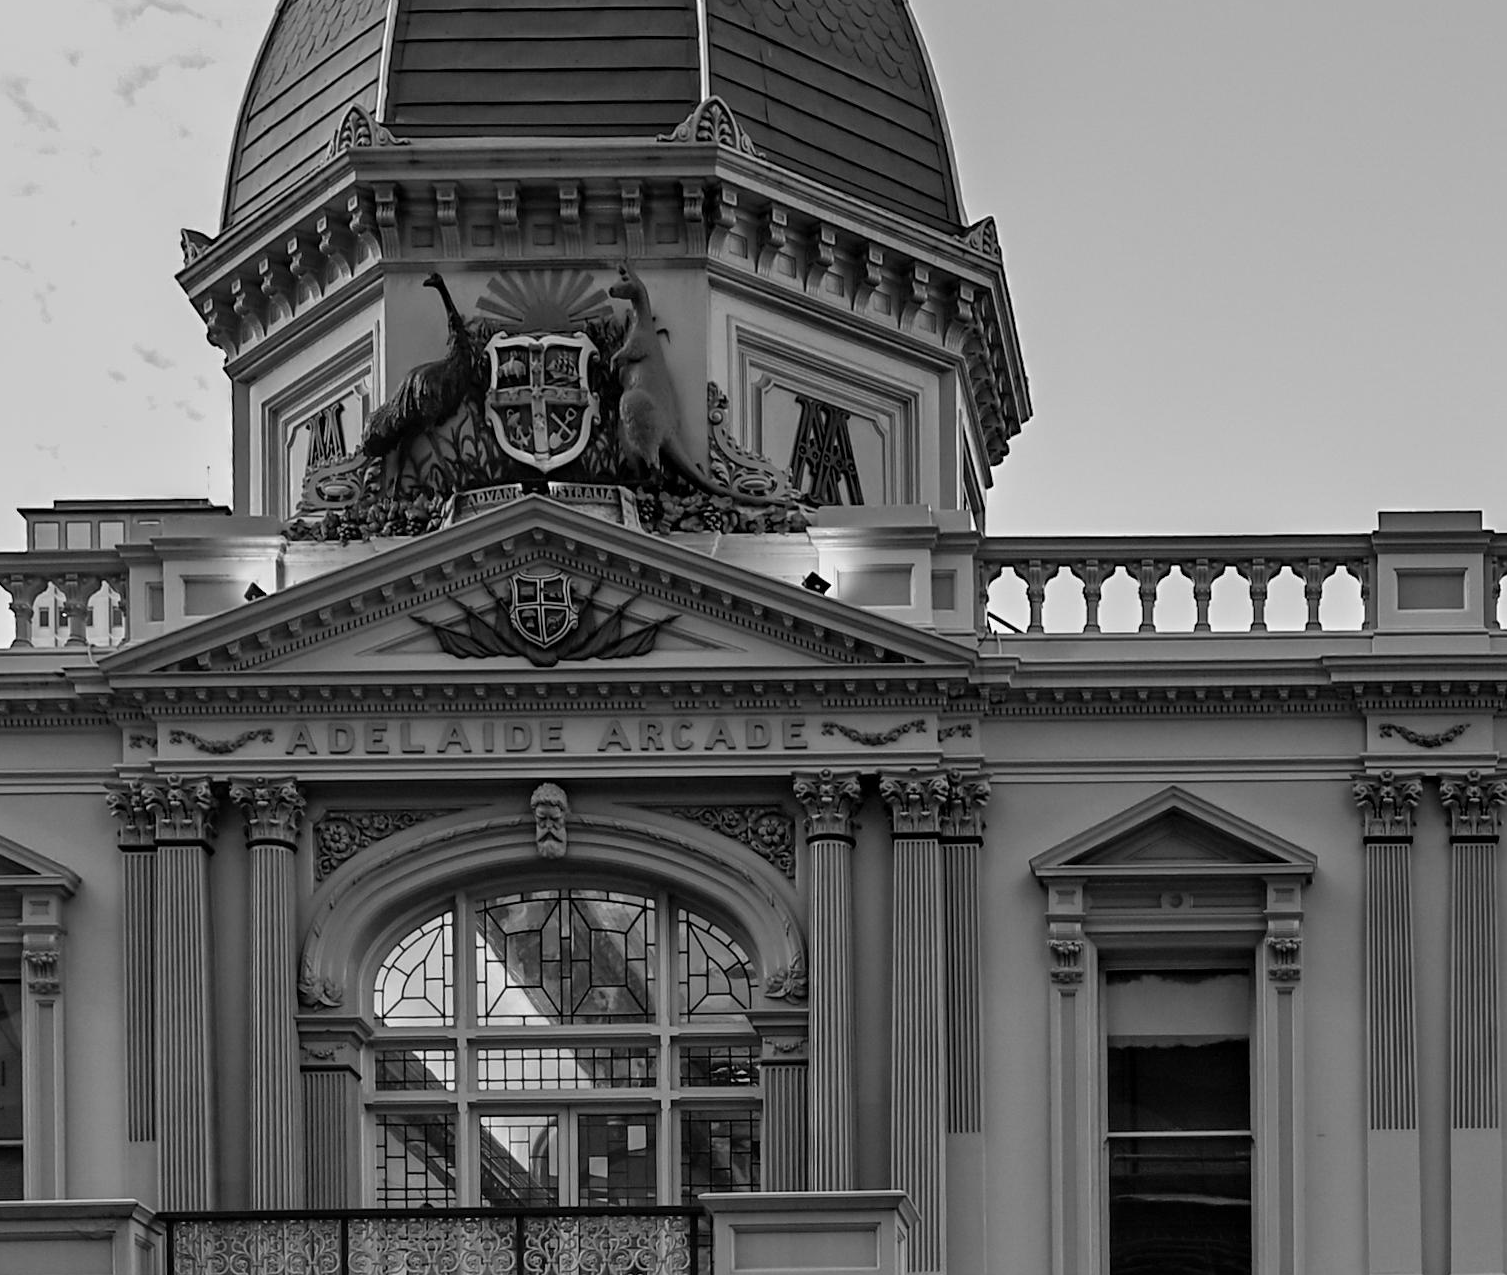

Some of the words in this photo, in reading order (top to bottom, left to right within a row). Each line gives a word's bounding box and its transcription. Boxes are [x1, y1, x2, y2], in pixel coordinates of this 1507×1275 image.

[468, 487, 522, 506] ADVANC
[549, 485, 613, 501] USTRALIA
[286, 722, 565, 755] ADELAIDE
[597, 718, 808, 751] ARCADE
